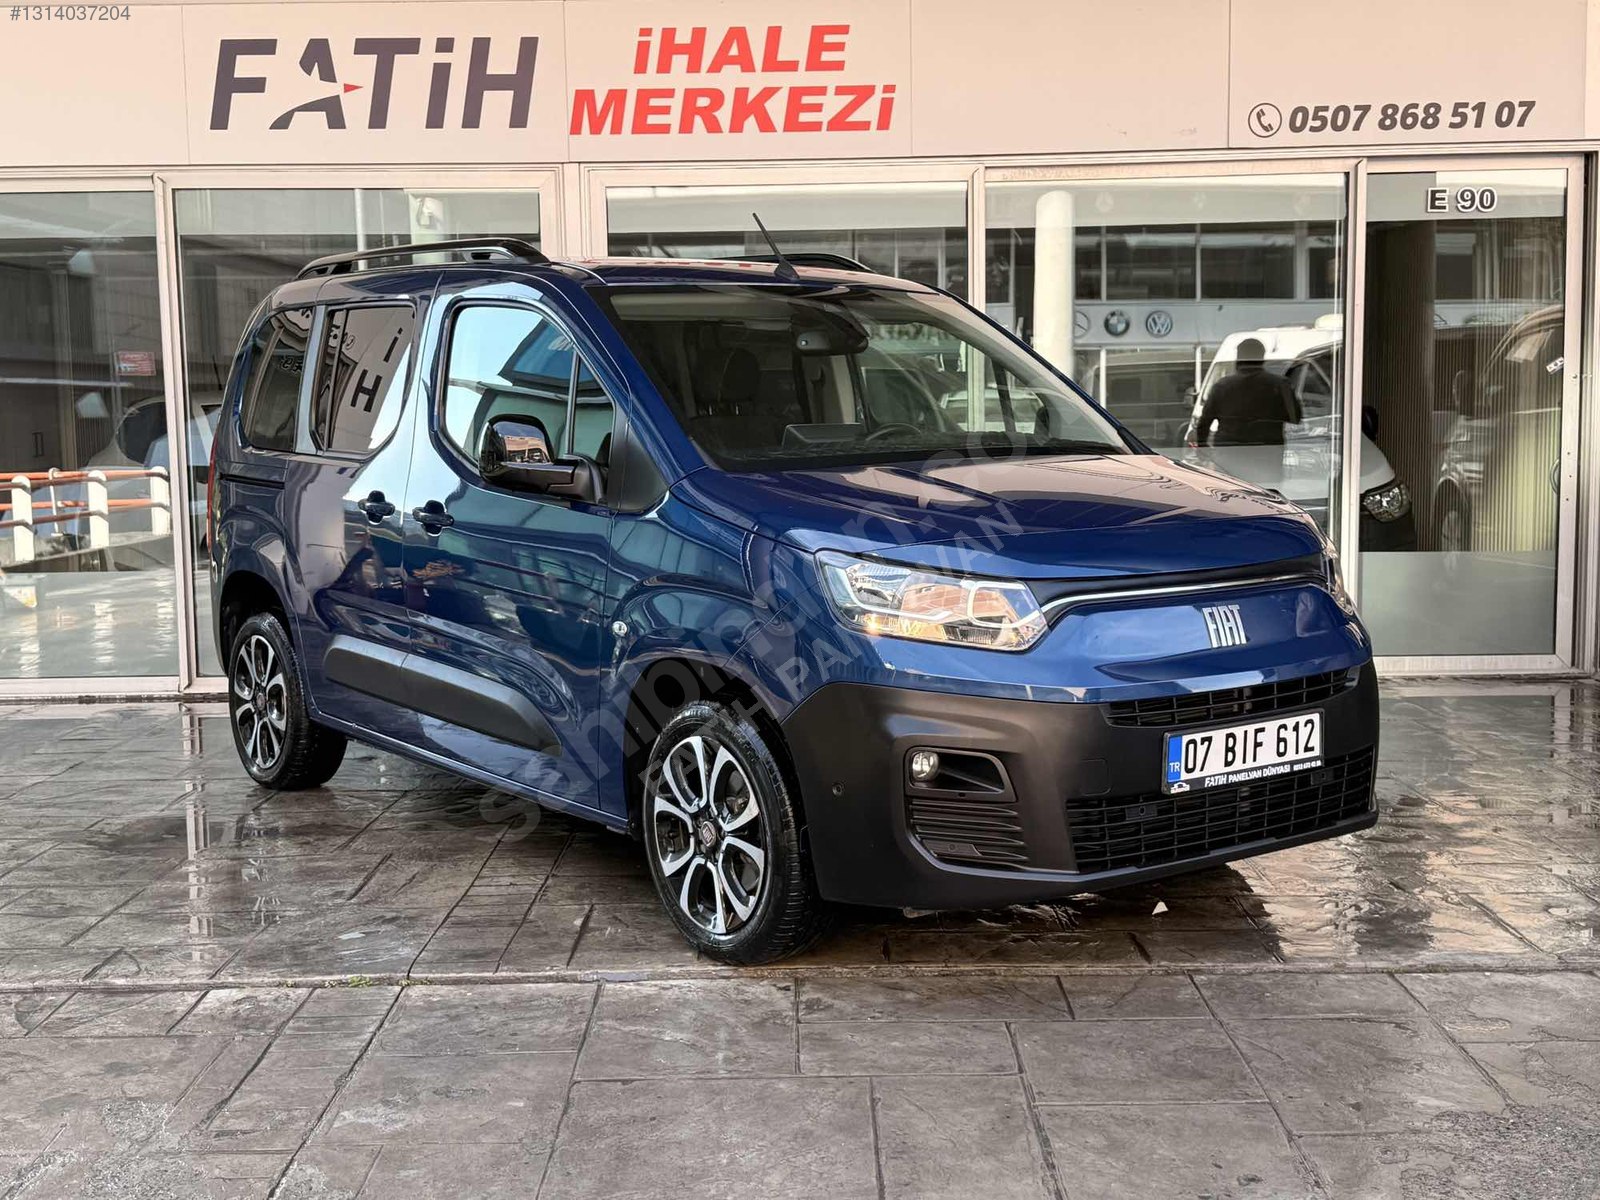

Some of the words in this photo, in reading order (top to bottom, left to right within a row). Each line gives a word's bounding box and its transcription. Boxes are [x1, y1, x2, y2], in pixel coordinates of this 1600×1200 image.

[1288, 104, 1372, 134] 0507
[1378, 102, 1442, 131] 868
[1448, 101, 1487, 129] 51
[1495, 99, 1536, 129] 07
[1427, 188, 1449, 213] E
[1457, 187, 1497, 213] 90
[1202, 604, 1247, 648] FIAT
[1169, 763, 1180, 773] TR
[1184, 735, 1213, 774] 07
[1225, 727, 1266, 768] BIF
[1276, 718, 1316, 758] 612
[1228, 768, 1263, 784] PANELVAN
